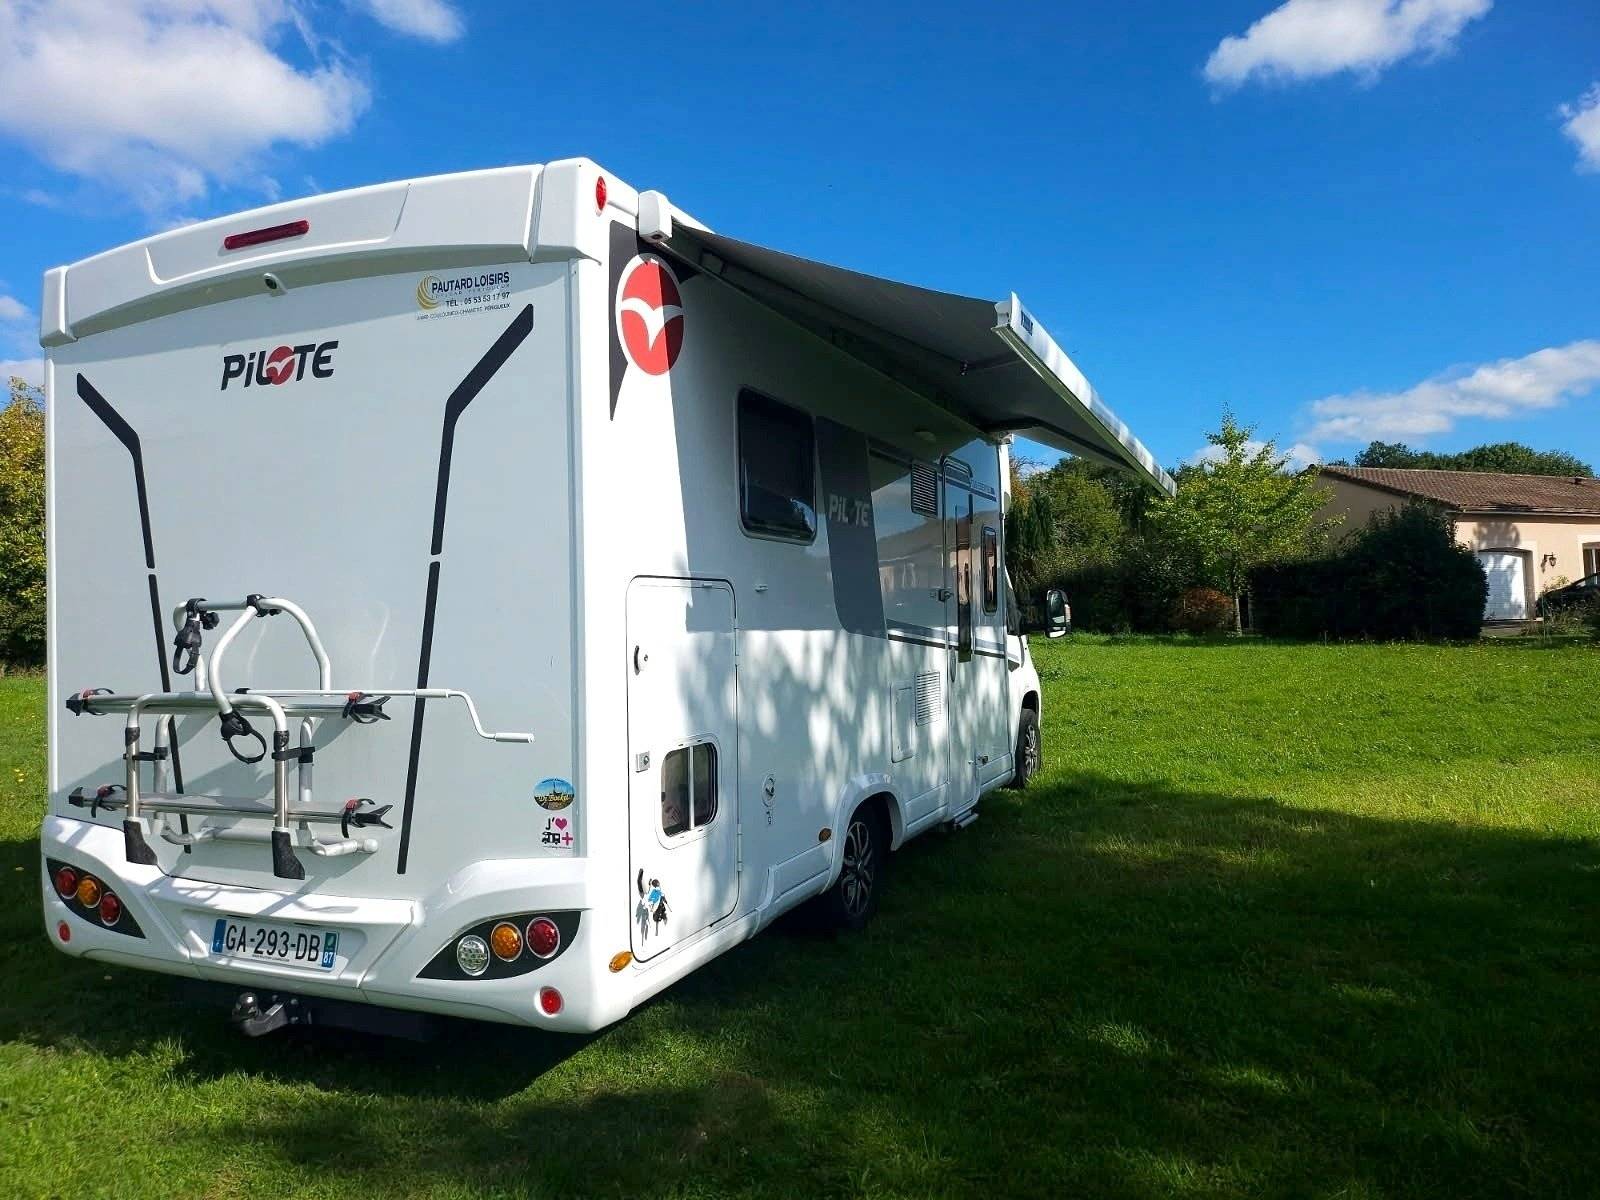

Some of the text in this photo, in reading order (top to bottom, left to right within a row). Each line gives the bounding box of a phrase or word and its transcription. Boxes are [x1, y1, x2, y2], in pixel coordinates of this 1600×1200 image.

[431, 271, 510, 294] PAUTARD LOISIRS
[464, 297, 472, 306] 05
[474, 296, 482, 304] 53
[483, 294, 491, 303] 53
[493, 293, 500, 301] 17
[502, 291, 510, 300] 97
[226, 925, 321, 962] GA-293-DB
[323, 951, 334, 964] 87
